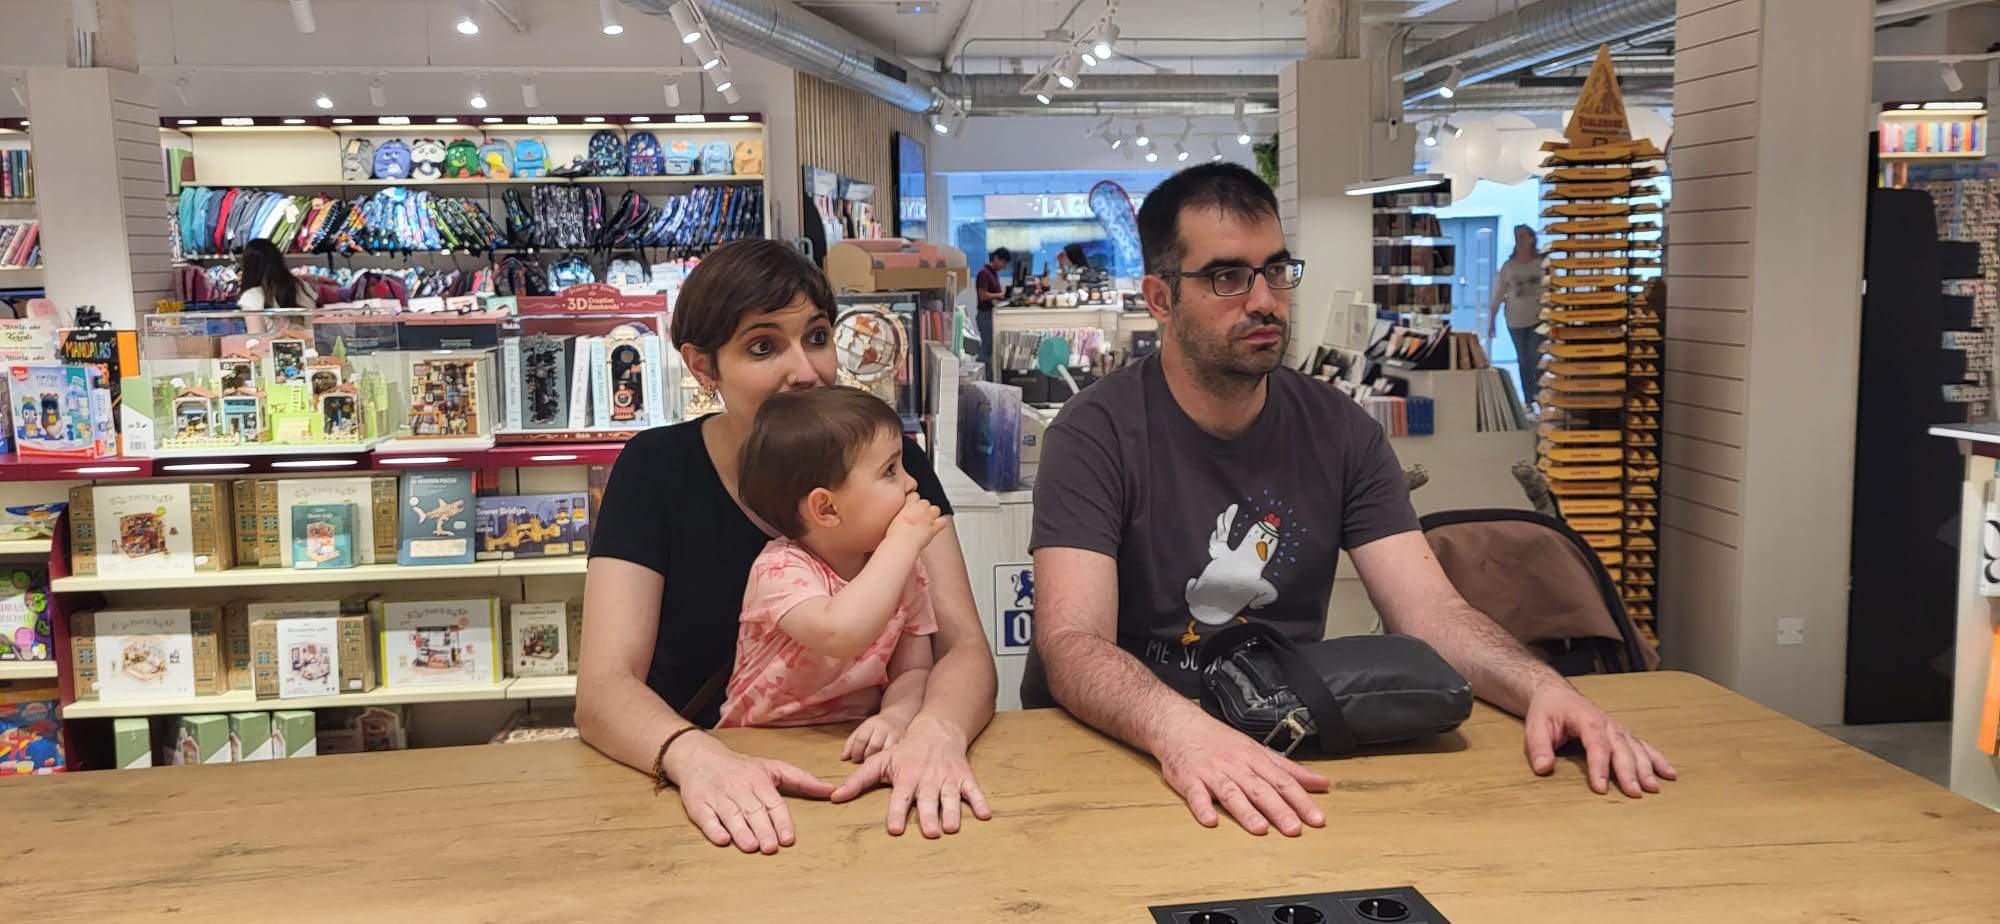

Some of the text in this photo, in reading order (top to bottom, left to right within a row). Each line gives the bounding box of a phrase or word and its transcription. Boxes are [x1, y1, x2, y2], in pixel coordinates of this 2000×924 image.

[567, 297, 588, 311] 3D
[500, 506, 527, 516] Bridge
[1146, 639, 1170, 664] ME
